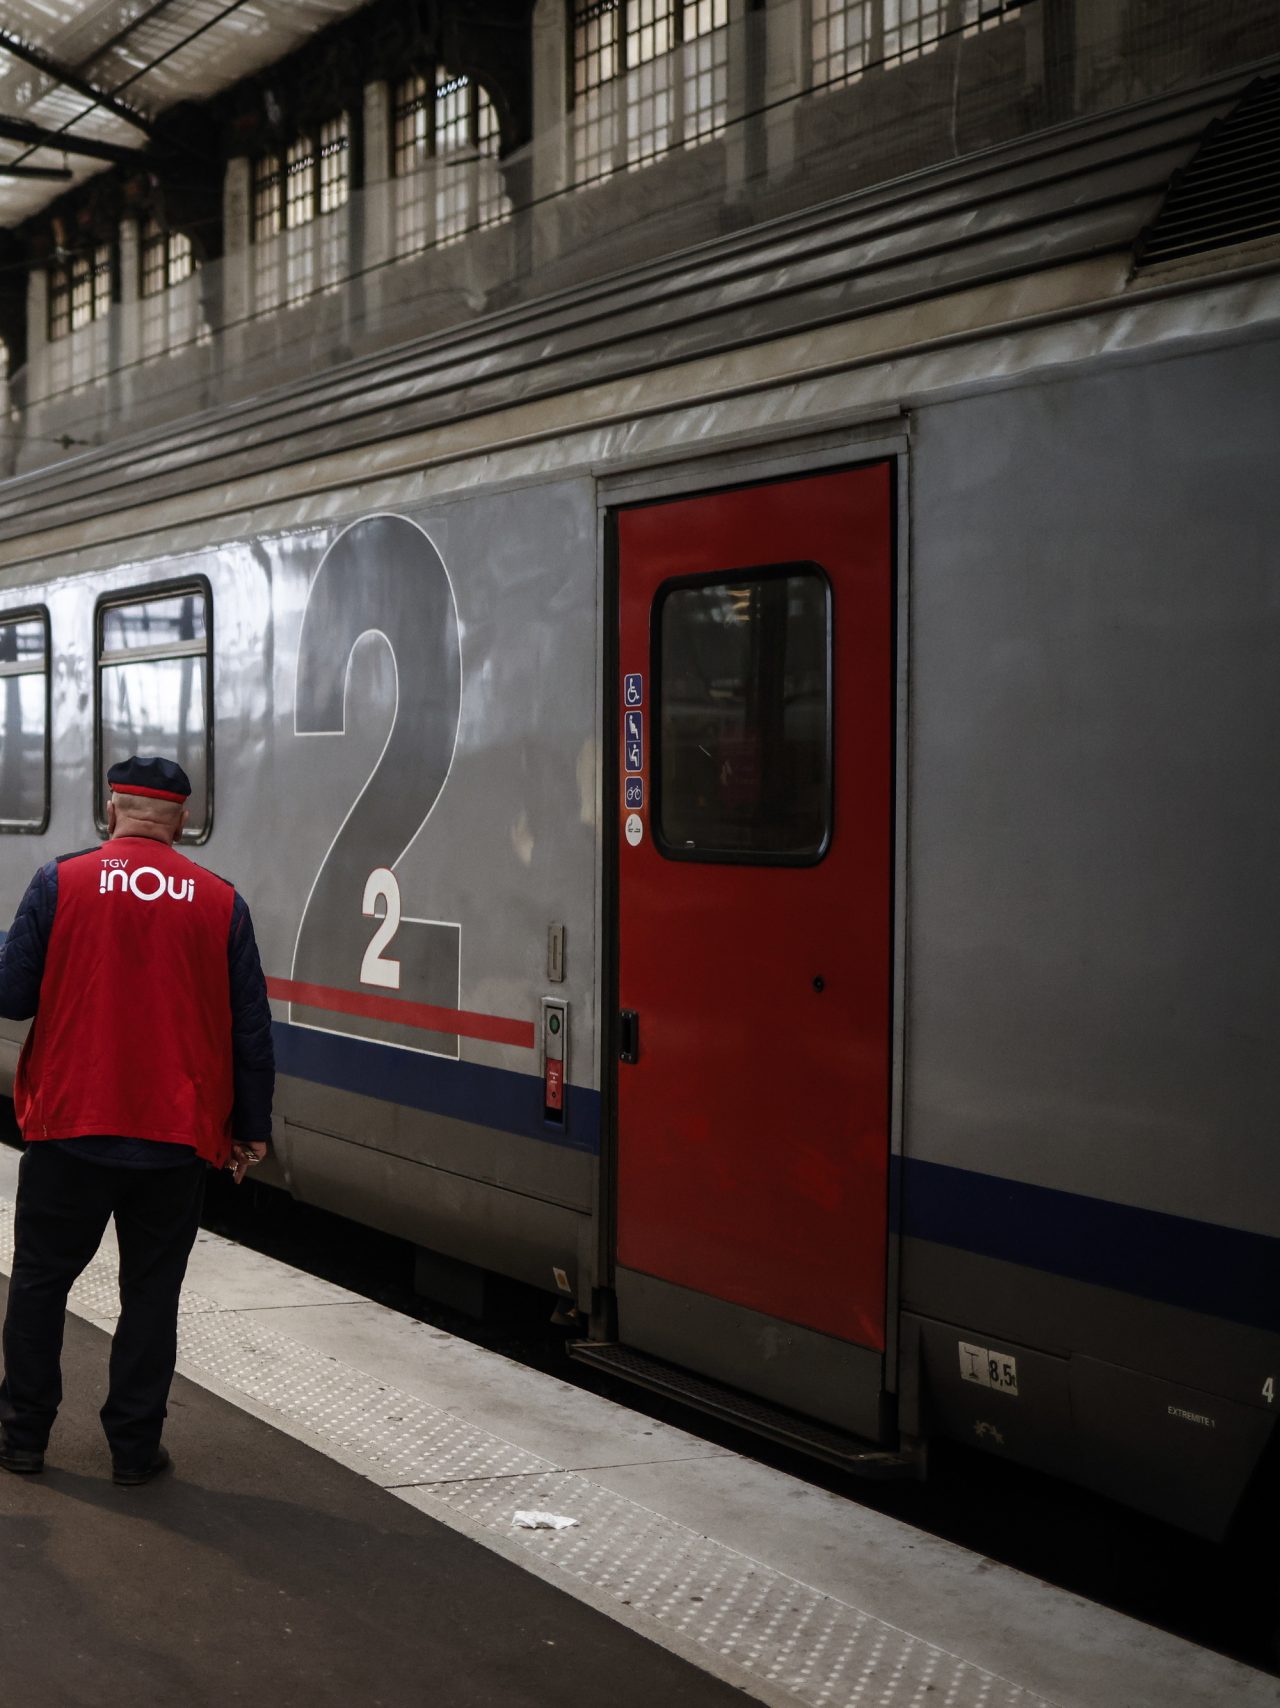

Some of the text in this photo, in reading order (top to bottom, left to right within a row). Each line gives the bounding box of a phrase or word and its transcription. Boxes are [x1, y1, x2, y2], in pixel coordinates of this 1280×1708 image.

[287, 512, 463, 1061] 2
[101, 859, 128, 868] TGV
[360, 868, 401, 989] 2
[1261, 1377, 1274, 1403] 4
